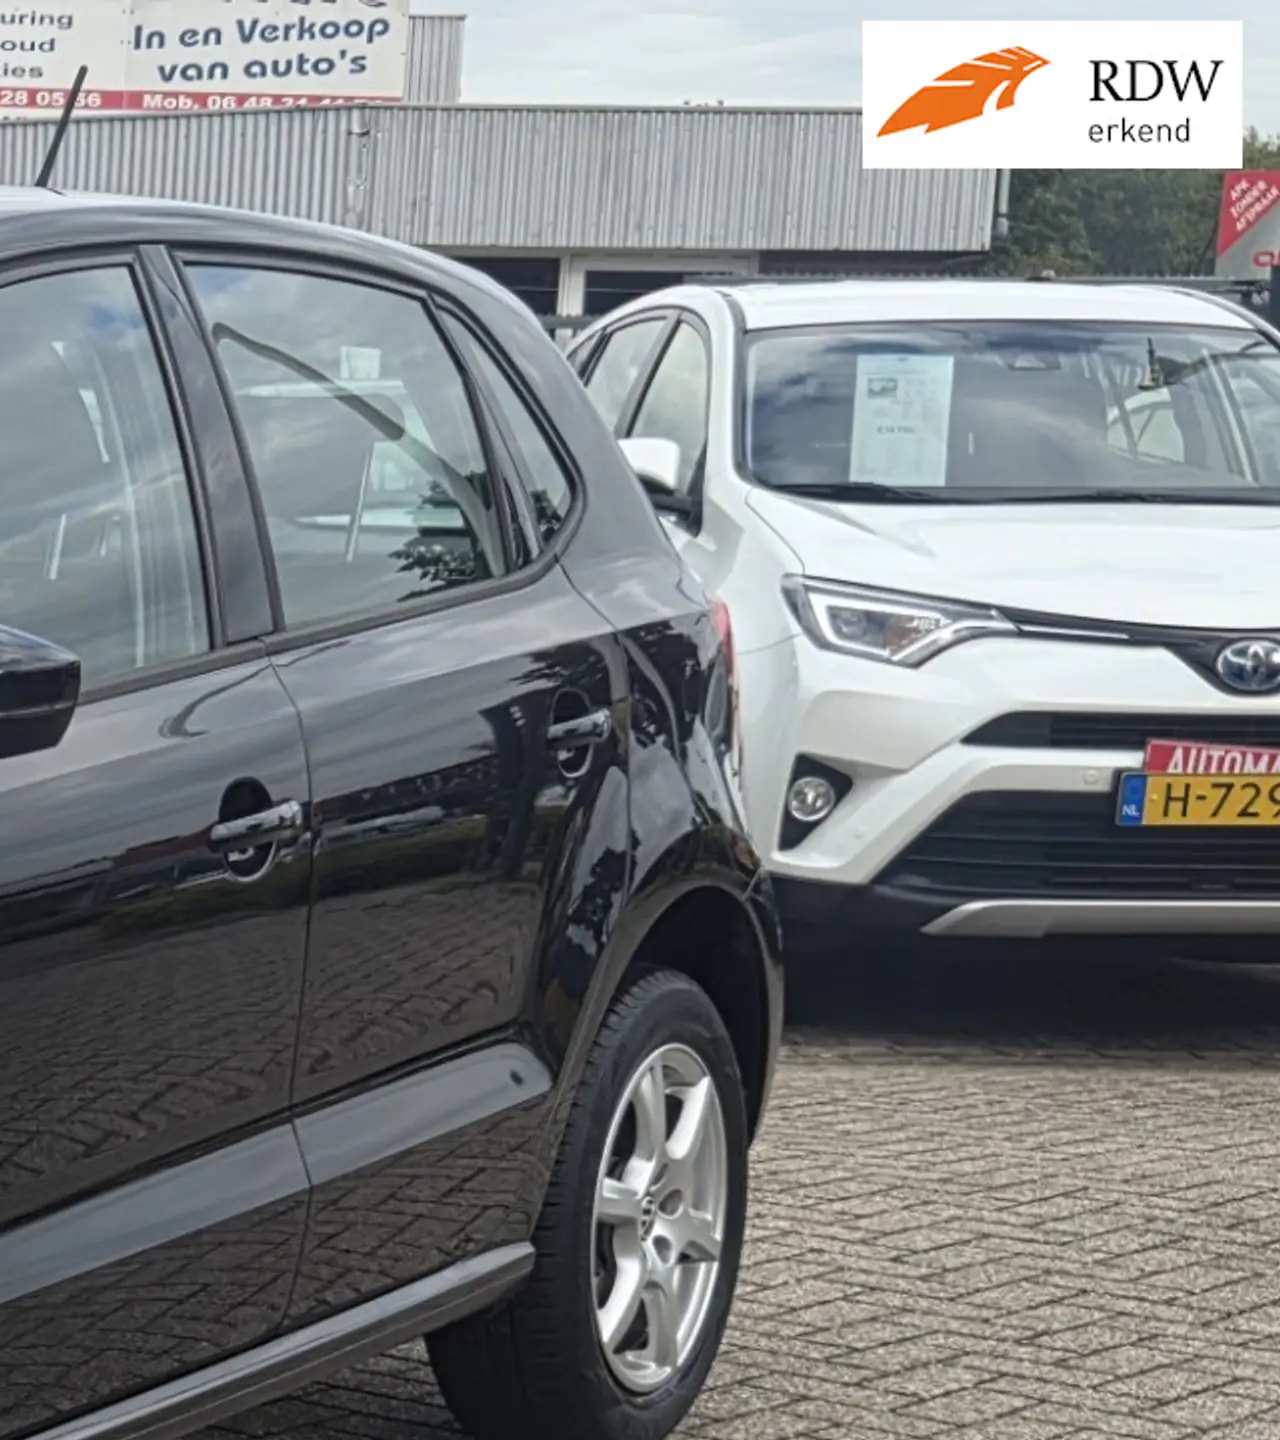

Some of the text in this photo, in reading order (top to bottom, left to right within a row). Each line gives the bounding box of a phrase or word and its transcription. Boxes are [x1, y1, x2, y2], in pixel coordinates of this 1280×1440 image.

[133, 16, 390, 50] In en Verkoop
[158, 49, 367, 83] van auto's
[0, 90, 29, 106] 28
[35, 91, 65, 107] 05
[142, 93, 200, 110] Mob.
[206, 95, 237, 110] 06
[1122, 803, 1141, 816] NL
